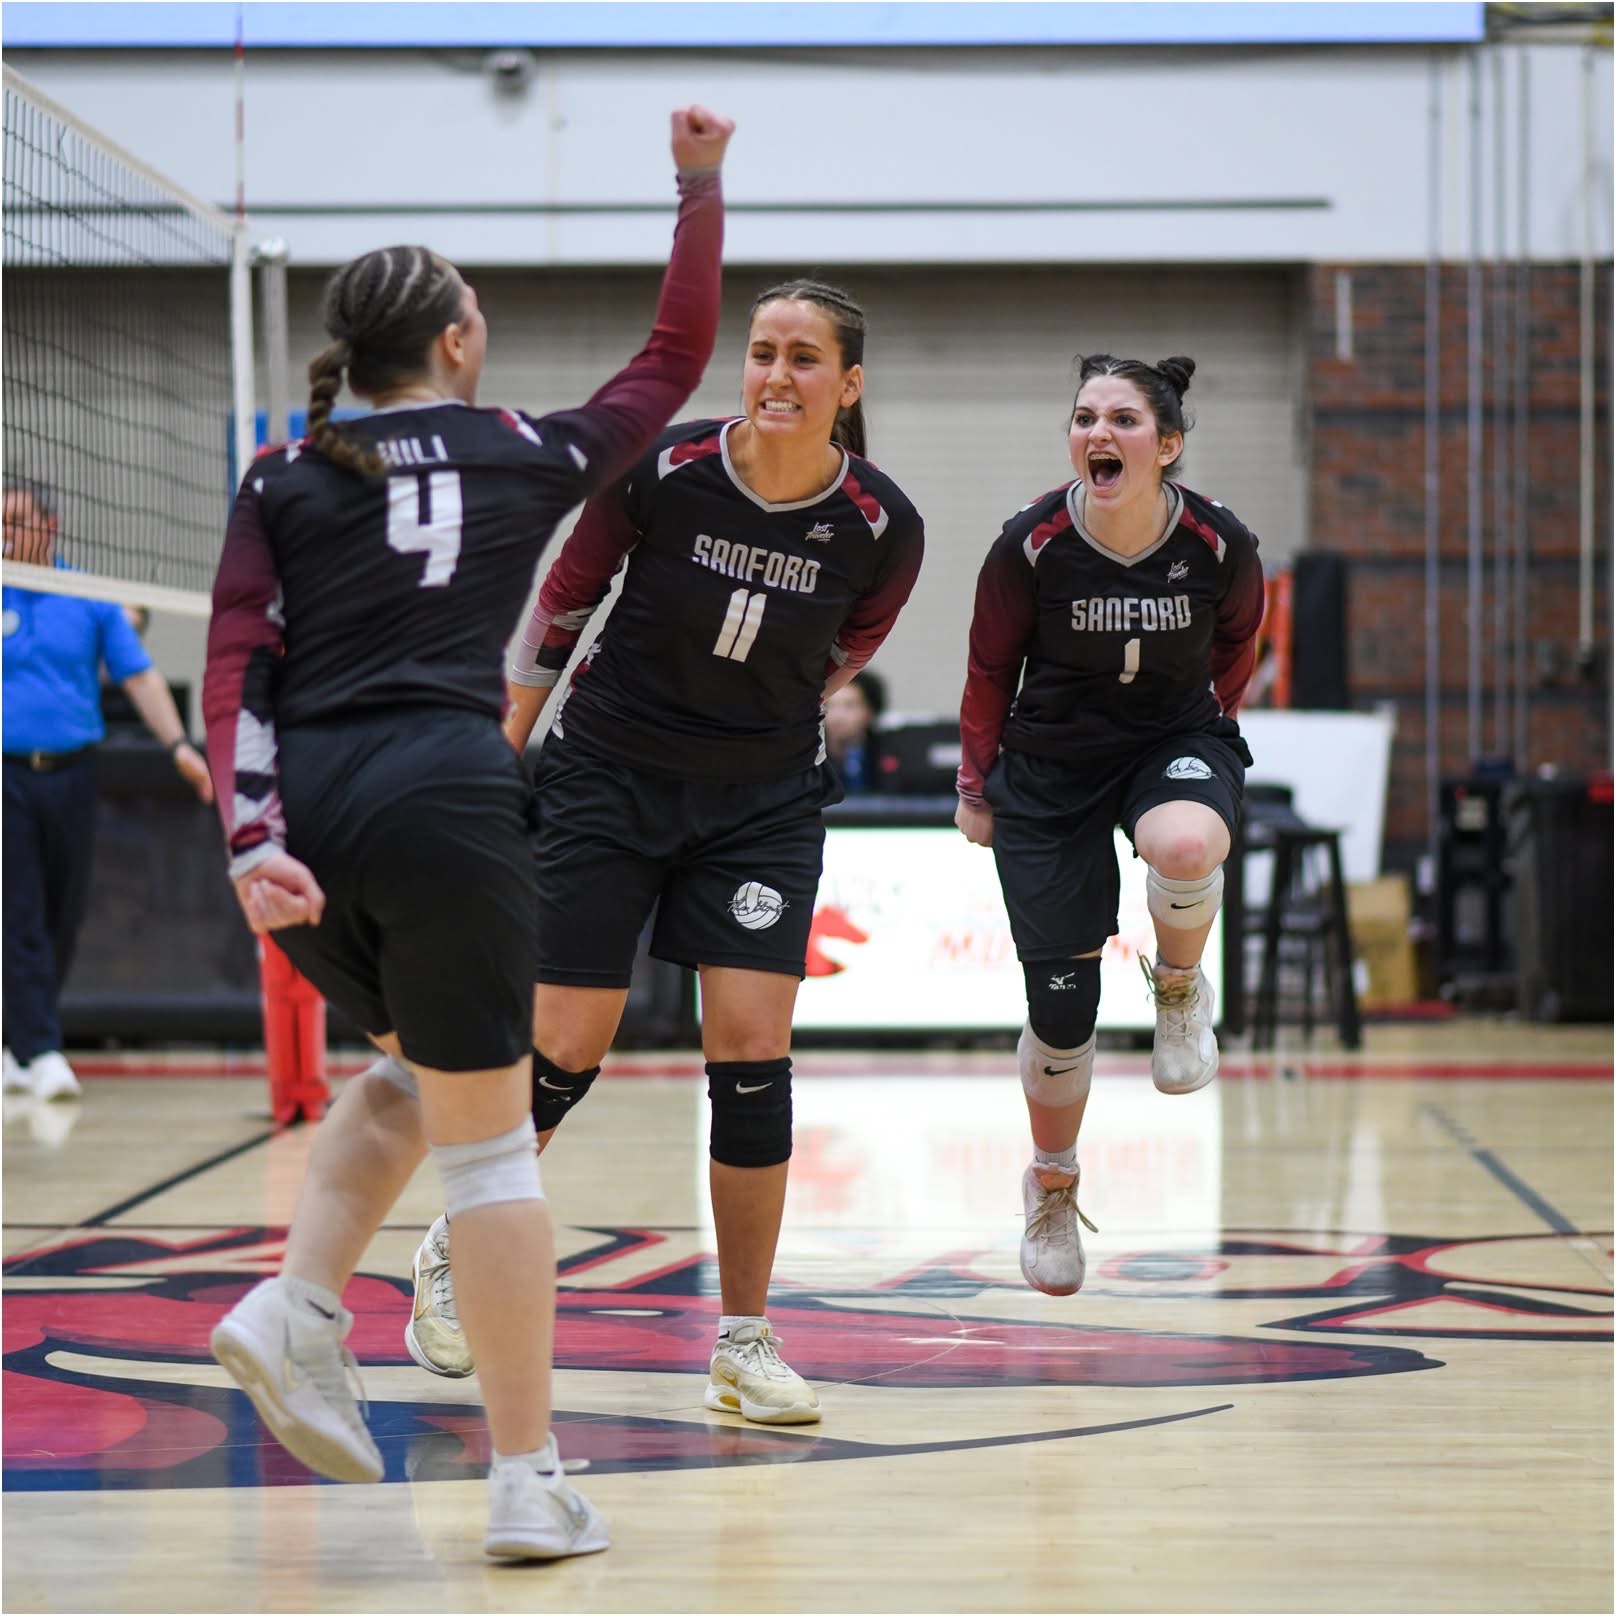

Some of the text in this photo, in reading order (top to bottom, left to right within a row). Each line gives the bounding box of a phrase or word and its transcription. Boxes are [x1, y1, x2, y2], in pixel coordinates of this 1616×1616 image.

[387, 470, 463, 588] 4
[691, 533, 822, 594] SANFORD
[712, 588, 768, 663] 11
[1071, 594, 1192, 632] SANFORD
[1118, 638, 1141, 684] 1
